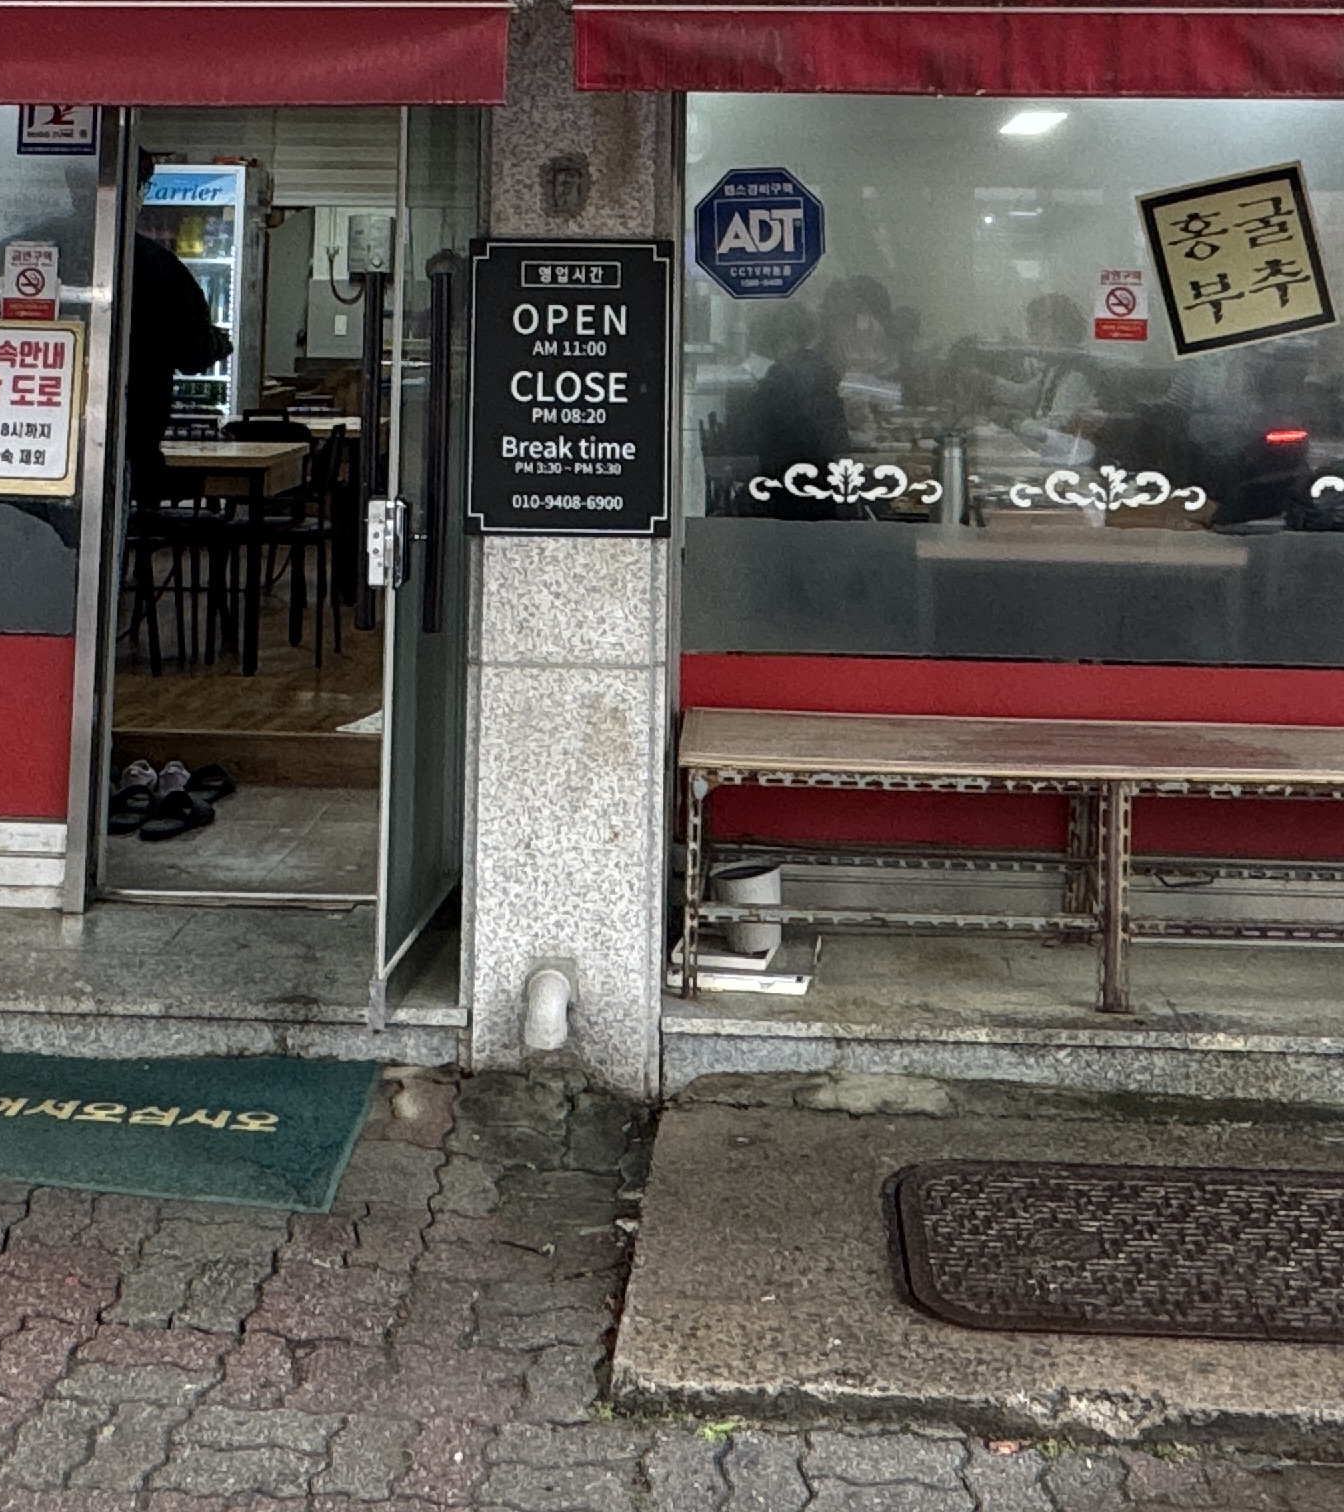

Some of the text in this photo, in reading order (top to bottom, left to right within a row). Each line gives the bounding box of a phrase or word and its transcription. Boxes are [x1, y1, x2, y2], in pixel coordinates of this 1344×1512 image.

[717, 208, 803, 254] ADT
[1167, 196, 1294, 261] 홍굴
[537, 265, 604, 284] 영업시간
[1183, 257, 1312, 325] 부추
[512, 303, 628, 336] OPEN
[532, 340, 607, 356] AM 11:00
[9, 374, 62, 407] 도로
[510, 370, 629, 404] CLOSE
[532, 407, 607, 424] PM 08:20
[19, 449, 47, 466] 제외
[501, 435, 637, 461] Break time
[514, 461, 534, 474] PM
[574, 462, 594, 474] PM
[511, 494, 624, 511] 010-9408-6900
